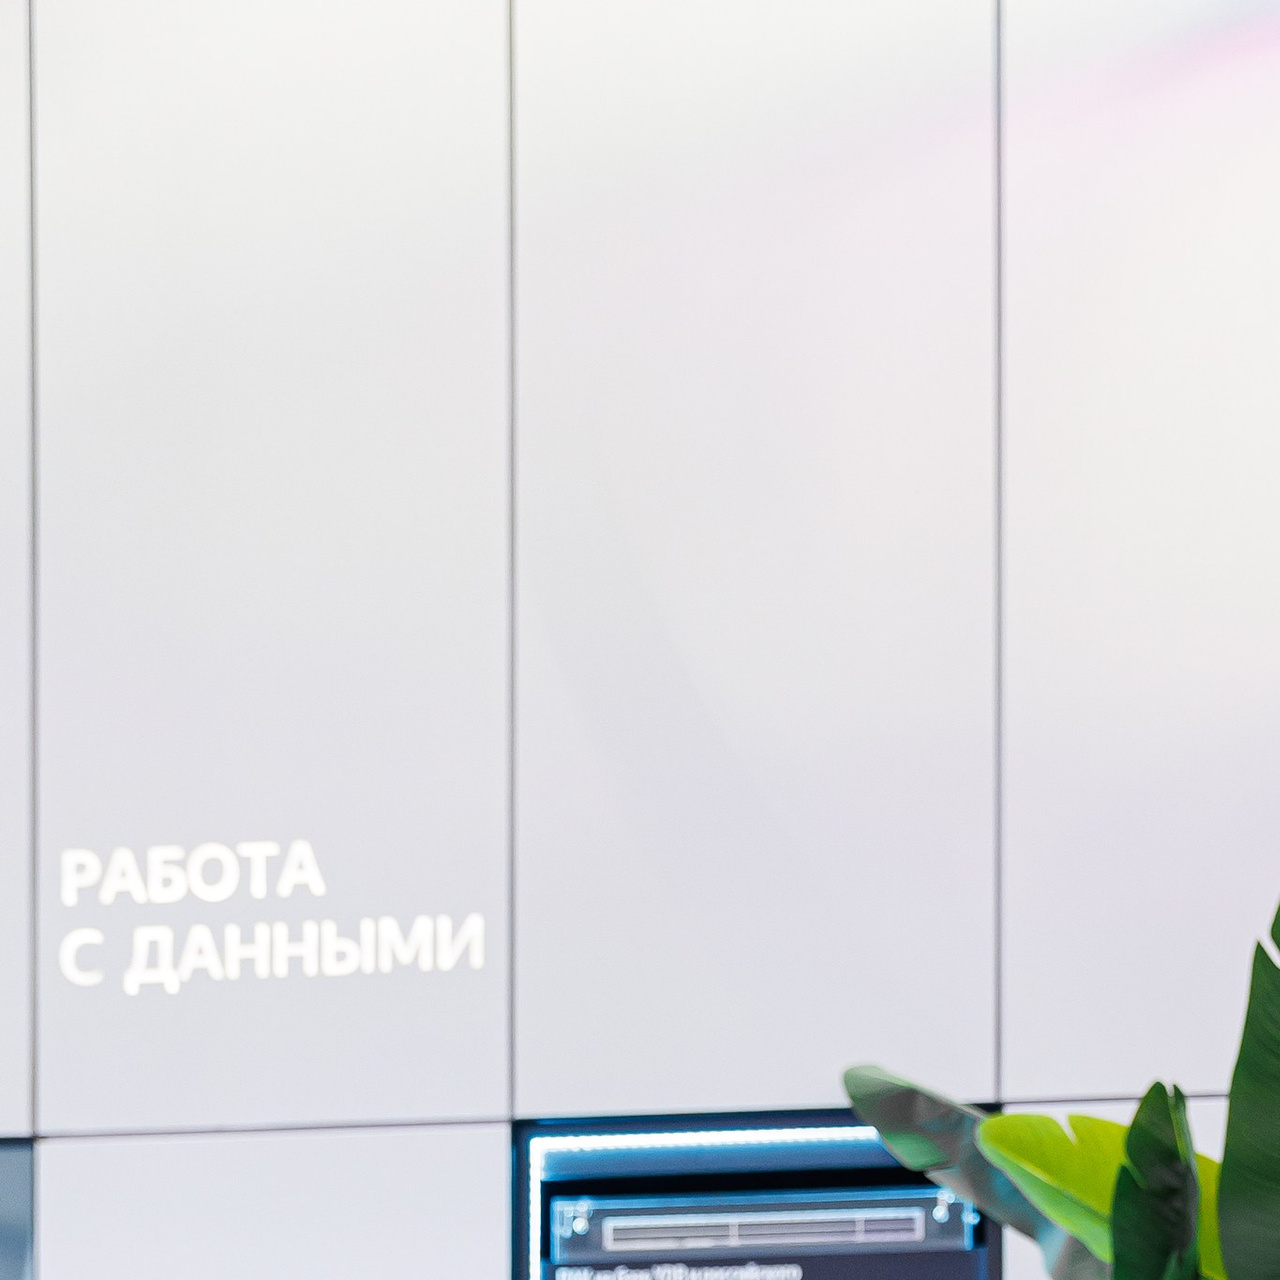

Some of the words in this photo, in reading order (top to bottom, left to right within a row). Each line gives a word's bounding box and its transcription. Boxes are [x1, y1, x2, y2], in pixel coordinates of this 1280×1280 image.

[59, 839, 327, 908] РАБОТА
[58, 926, 104, 987] С
[122, 911, 486, 997] ДАННЫМИ
